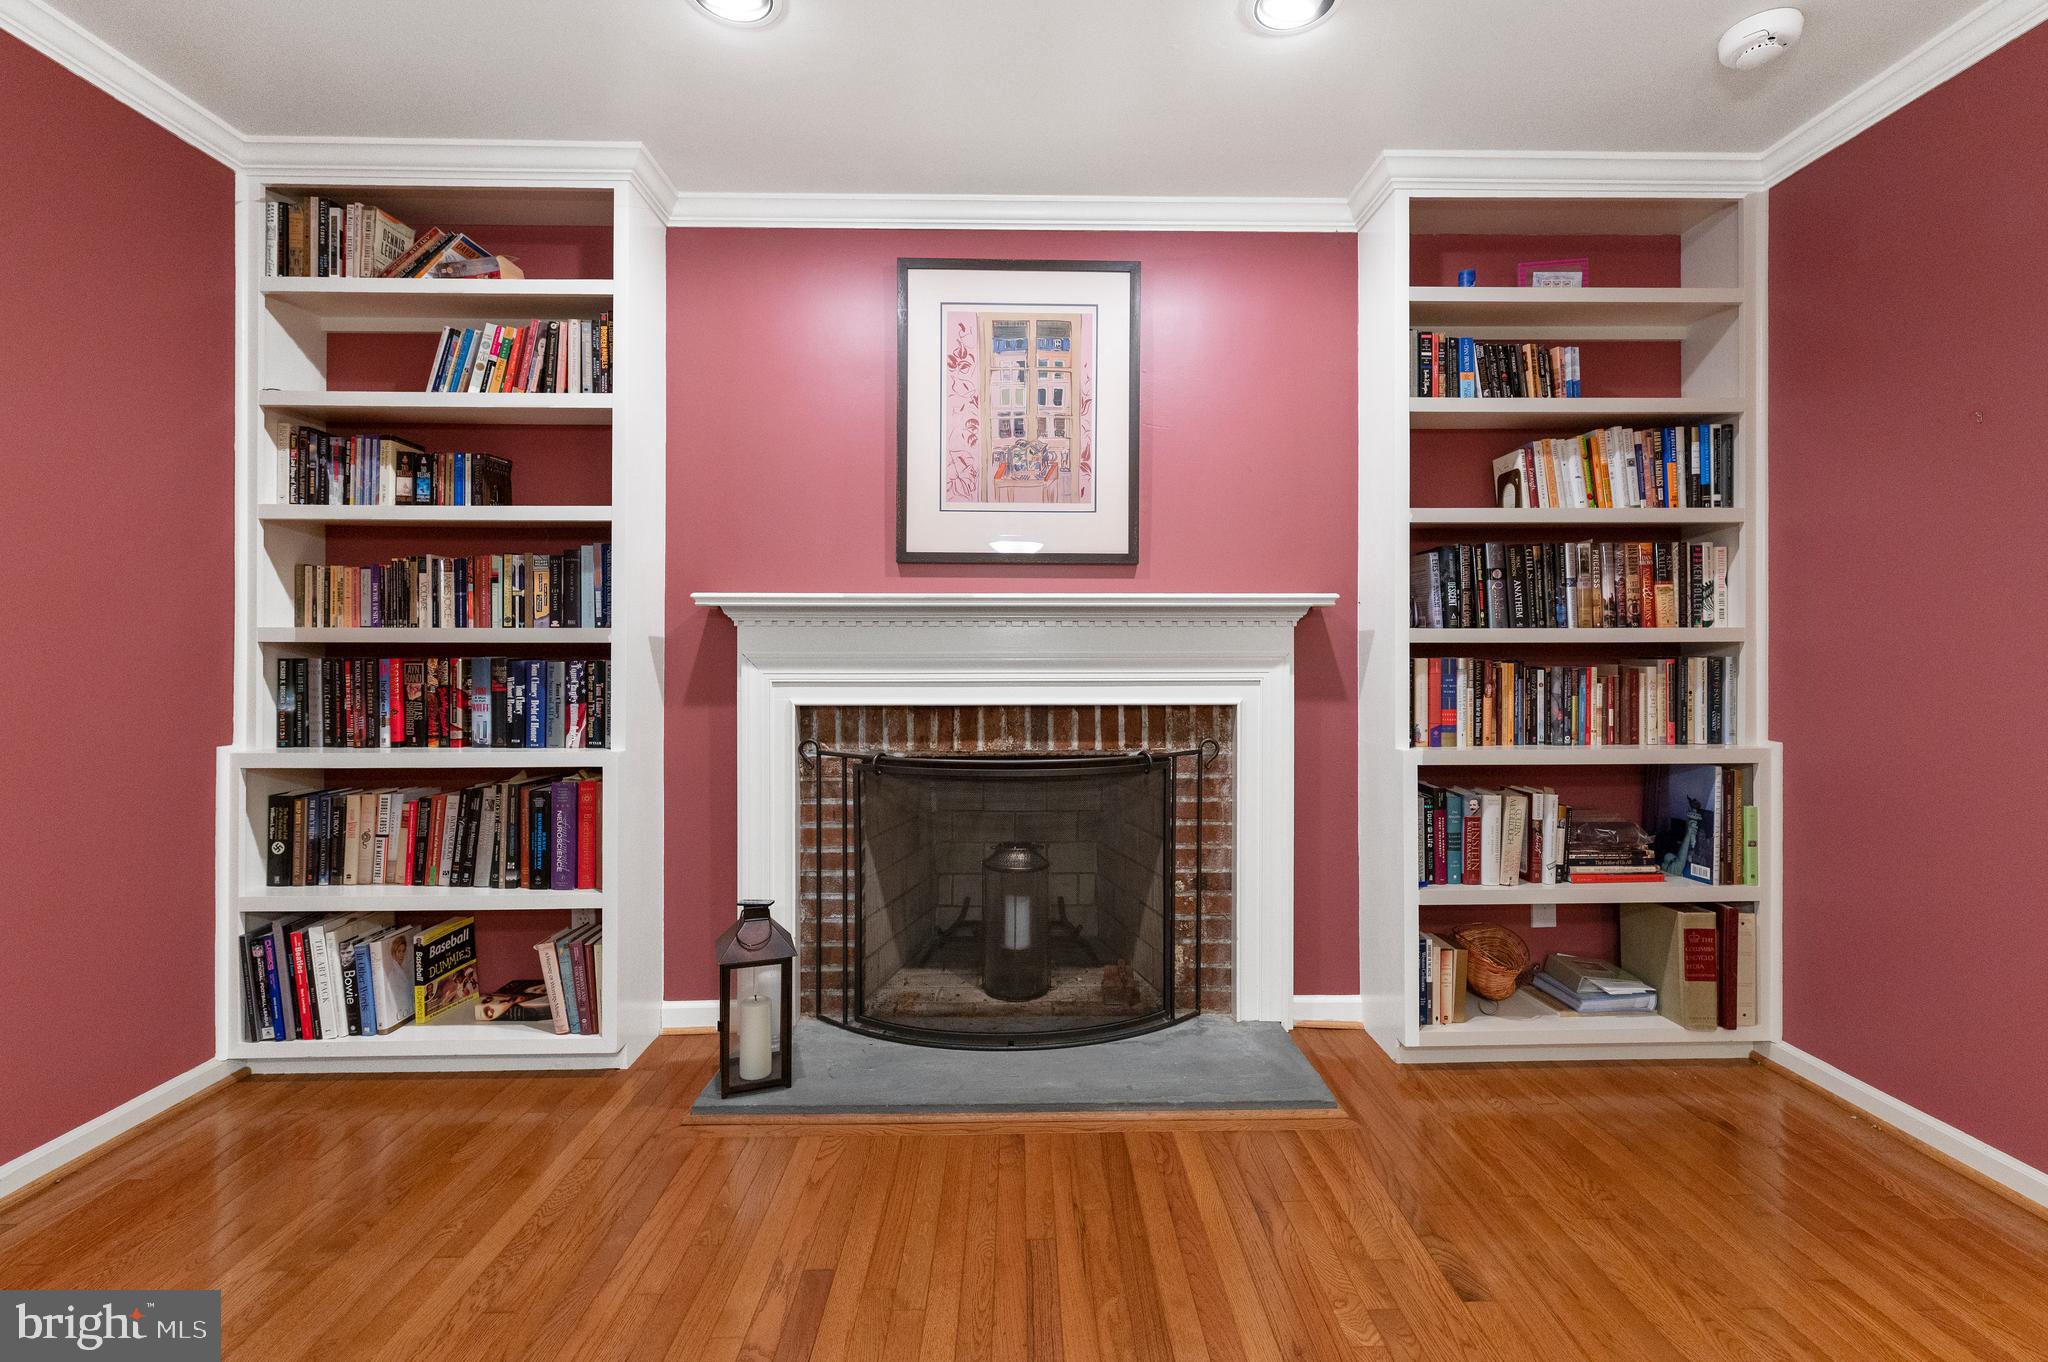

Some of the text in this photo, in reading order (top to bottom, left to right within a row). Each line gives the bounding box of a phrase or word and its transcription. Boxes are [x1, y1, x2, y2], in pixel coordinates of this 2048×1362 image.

[383, 228, 406, 252] DENNIS
[1525, 548, 1534, 579] GIRLS
[1592, 550, 1600, 589] PRICELESS
[1448, 581, 1457, 607] DESCENT
[1513, 580, 1523, 618] ANATHEM
[1694, 564, 1702, 617] KEN FOLLETT
[570, 665, 579, 680] Tom
[507, 677, 515, 723] Without Remorse
[513, 685, 525, 715] Tom Clancy
[529, 663, 540, 742] Tom Clancy Debt of Honor
[569, 681, 579, 704] Clancy
[595, 698, 603, 718] Clancy
[406, 701, 414, 736] SHRUGGED
[414, 702, 423, 720] ATLAS
[380, 798, 389, 833] DOUBLE CROSS
[1472, 821, 1480, 871] EINSTEIN
[375, 851, 383, 878] MACINTYRE
[429, 928, 470, 959] Baseball
[295, 947, 304, 974] Beatles
[315, 939, 330, 1004] THE ART PACK
[358, 962, 367, 985] Other
[428, 947, 472, 978] DUMMIES
[344, 970, 358, 1004] Bowie
[361, 986, 369, 1012] Words
